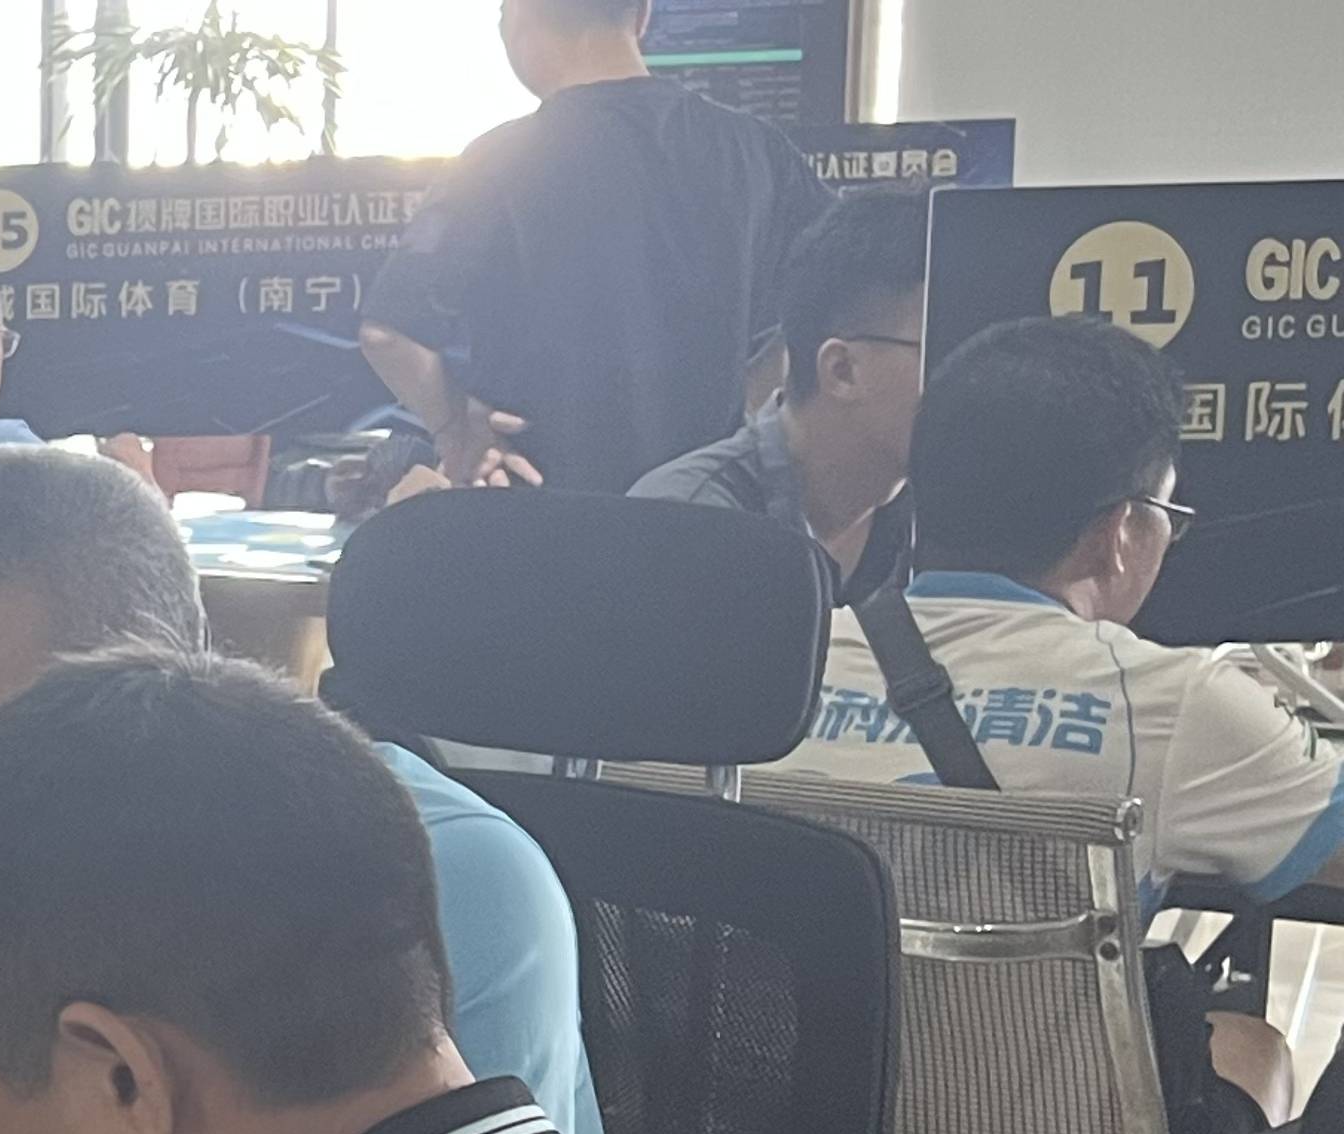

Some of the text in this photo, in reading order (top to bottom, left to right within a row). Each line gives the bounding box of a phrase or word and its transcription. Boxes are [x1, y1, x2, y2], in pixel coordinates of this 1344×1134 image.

[803, 149, 957, 179] 认证委员会
[66, 243, 97, 259] GIC
[102, 240, 190, 257] GUANPAI
[199, 236, 353, 255] INTERNATIONAL
[1246, 237, 1342, 301] GIC
[1070, 258, 1176, 324] 11
[1242, 315, 1296, 340] GIC
[1179, 379, 1344, 441] 国际
